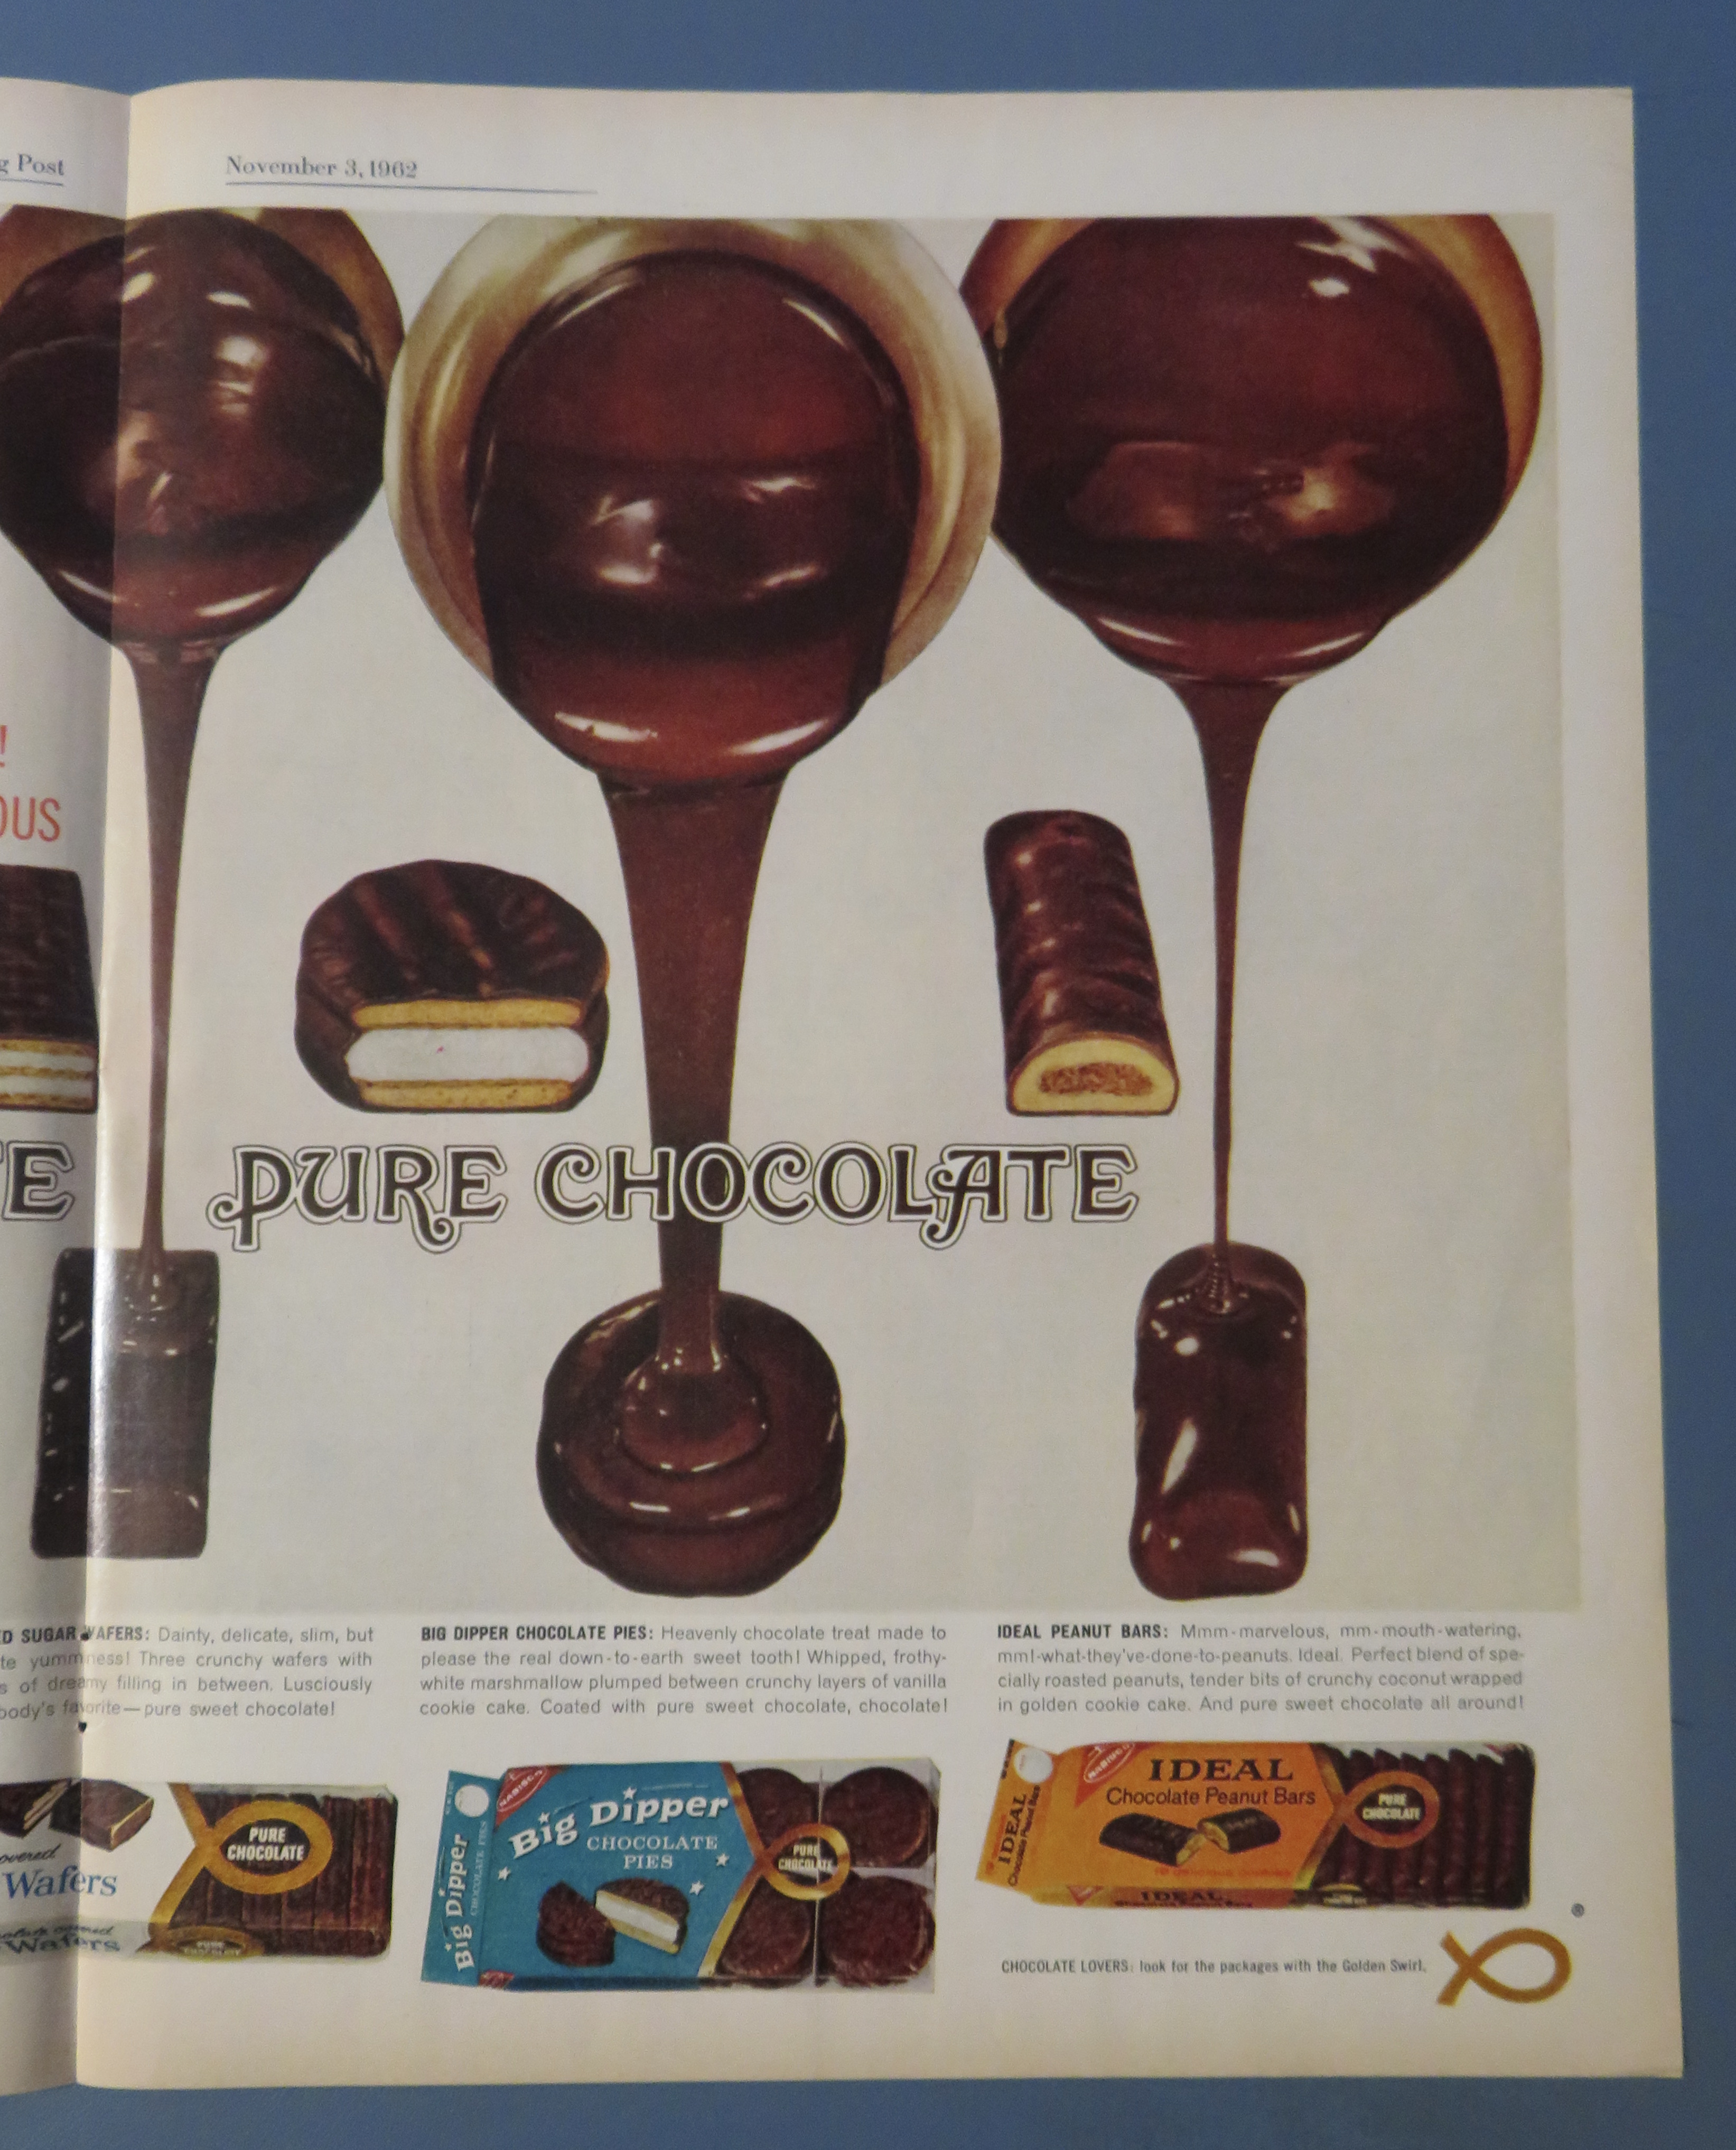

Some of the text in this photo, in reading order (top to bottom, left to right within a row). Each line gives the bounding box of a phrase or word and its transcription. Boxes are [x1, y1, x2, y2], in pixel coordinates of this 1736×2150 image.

[18, 153, 64, 175] Post
[226, 156, 337, 177] November
[369, 160, 417, 179] 1962
[207, 1141, 1139, 1253] PURE CHOCOLATE
[22, 1625, 77, 1643] SUGAR
[159, 1627, 214, 1645] Dainty,
[222, 1628, 293, 1643] delicate,
[301, 1628, 339, 1644] slim,
[347, 1627, 374, 1642] but
[421, 1625, 946, 1643] BIG DIPPER CHOCOLATE PIES: Heavenly chocolate treat made to
[997, 1624, 1041, 1639] IDEAL
[1051, 1624, 1112, 1639] PEANUT
[1121, 1624, 1168, 1639] BARS:
[141, 1651, 185, 1666] Three
[196, 1653, 263, 1670] crunchy
[272, 1651, 328, 1667] wafers
[339, 1652, 372, 1667] with
[422, 1651, 476, 1669] please
[484, 1651, 510, 1665] the
[520, 1651, 551, 1665] real
[694, 1650, 741, 1664] sweet
[751, 1650, 799, 1665] tooth!
[807, 1650, 885, 1667] Whipped,
[894, 1649, 946, 1668] frothy-
[1352, 1647, 1411, 1661] Perfect
[1417, 1647, 1462, 1661] blend
[1468, 1647, 1484, 1661] of
[1489, 1649, 1523, 1662] spe-
[20, 1678, 36, 1693] of
[48, 1676, 106, 1691] dreamy
[117, 1675, 161, 1693] filling
[173, 1678, 186, 1690] in
[284, 1676, 372, 1695] Lusciously
[420, 1674, 946, 1692] white marshmallow plumped between crunchy layers of vanilla
[998, 1671, 1523, 1690] cially roasted peanuts, tender bits of crunchy coconut wrapped
[190, 1702, 238, 1716] sweet
[246, 1701, 334, 1716] chocolate!
[419, 1698, 947, 1716] cookie cake. Coated with pure sweet chocolate, chocolate!
[998, 1695, 1523, 1715] in golden cookie cake. And pure sweet chocolate all around!
[1147, 1758, 1293, 1781] IDEAL
[1106, 1787, 1316, 1806] Chocolate Peanut Bars
[508, 1787, 729, 1859] Big Dipper
[998, 1794, 1026, 1864] IDEAL
[249, 1827, 286, 1842] PURE
[586, 1835, 717, 1852] CHOCOLATE
[227, 1844, 304, 1862] CHOCOLATE
[793, 1845, 820, 1857] PURE
[623, 1854, 674, 1870] PIES
[3, 1864, 118, 1899] Wafers
[438, 1834, 474, 1971] Big Dipper
[1001, 1958, 1426, 1975] CHOCOLATE LOVERS: look for the packages with the Golden Swirl.
